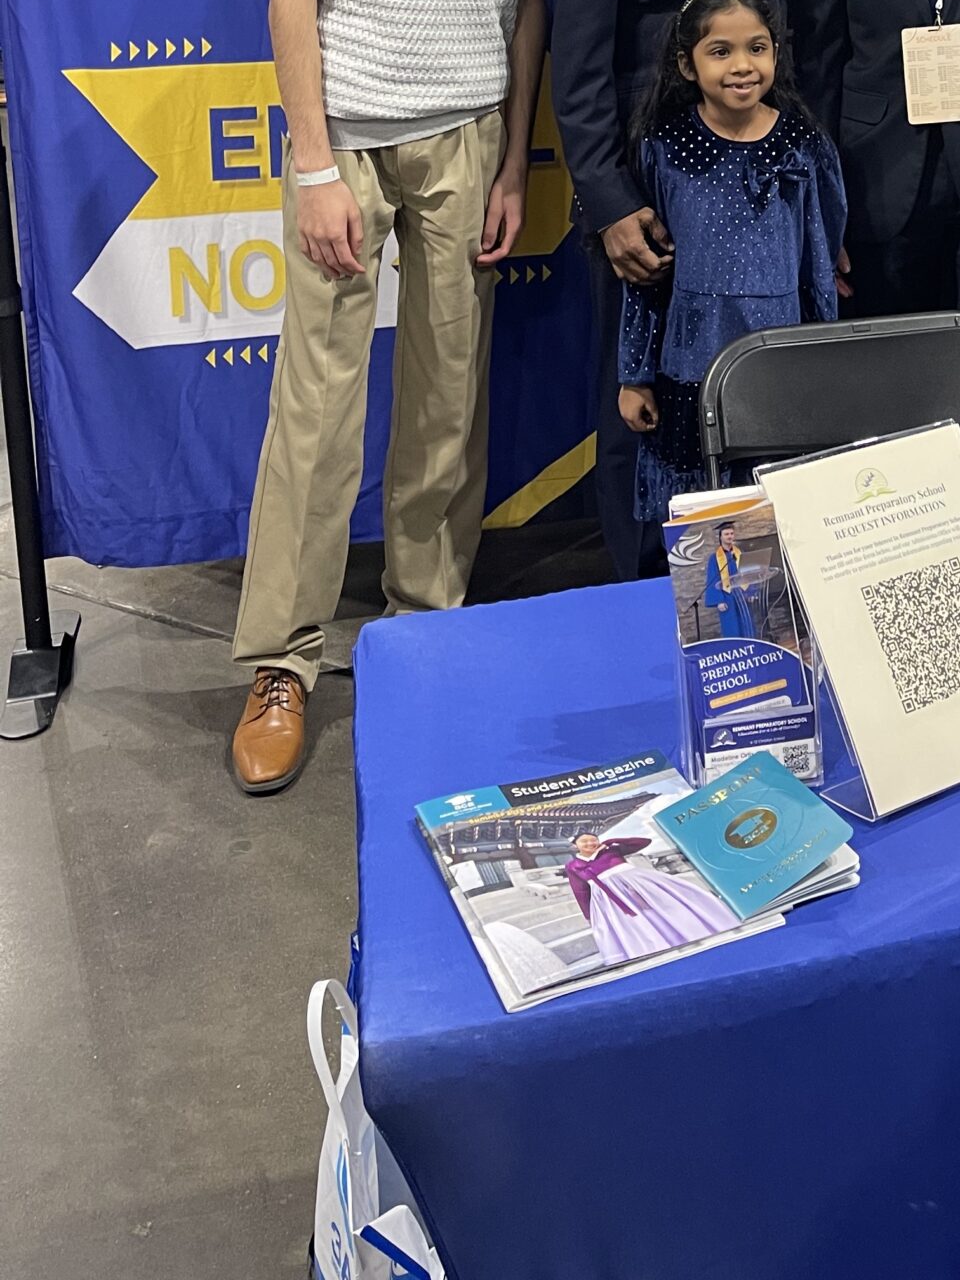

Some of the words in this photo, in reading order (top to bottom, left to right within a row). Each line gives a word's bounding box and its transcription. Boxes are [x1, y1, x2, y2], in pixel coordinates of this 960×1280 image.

[168, 240, 285, 318] NO
[823, 508, 864, 527] Remnant
[866, 493, 917, 515] Preparatory
[917, 483, 946, 501] School
[835, 520, 881, 540] REQUEST
[881, 500, 947, 526] INFORMATION
[699, 645, 755, 669] REMNANT
[701, 650, 784, 682] PREPARATORY
[703, 674, 751, 696] SCHOOL
[732, 724, 754, 732] REMNANT
[755, 720, 786, 729] PREPARATORY
[511, 777, 576, 798] Student
[578, 756, 656, 784] Magazine
